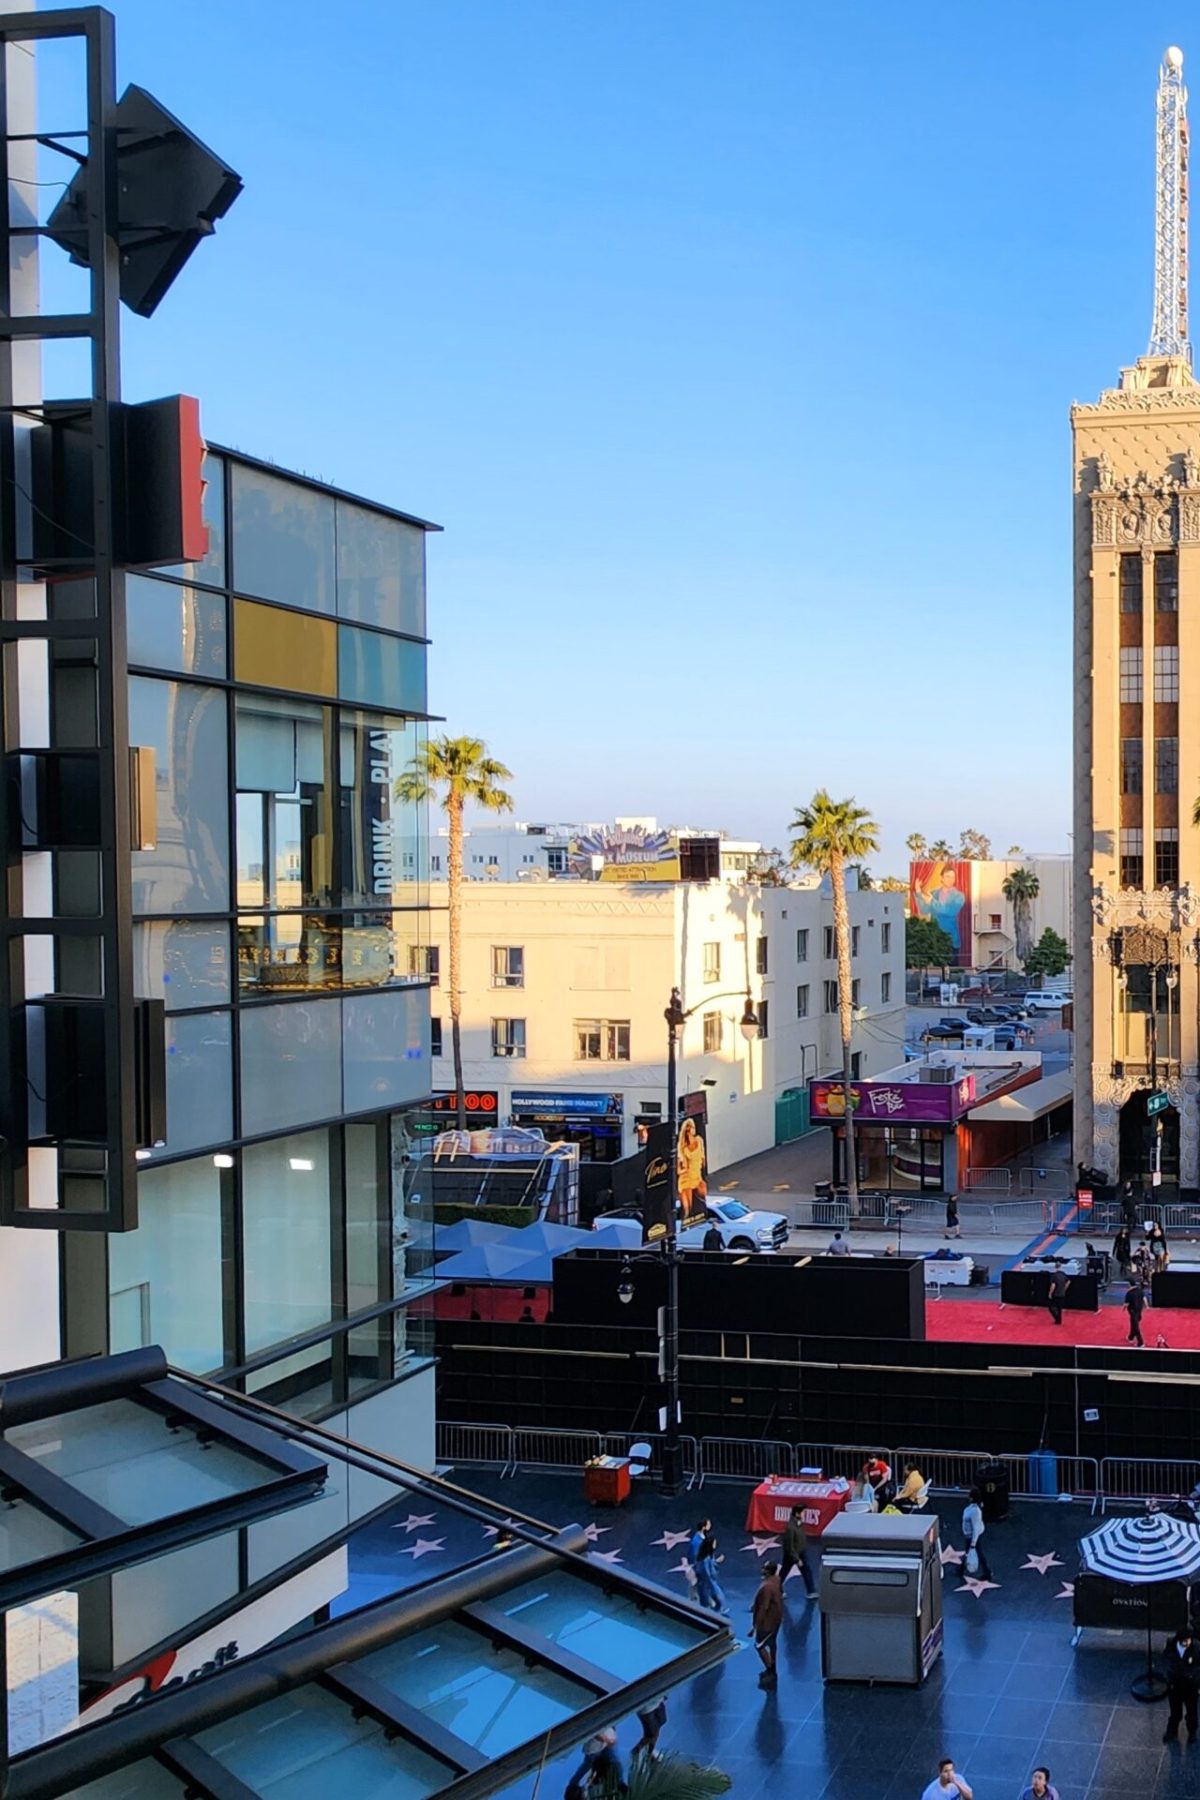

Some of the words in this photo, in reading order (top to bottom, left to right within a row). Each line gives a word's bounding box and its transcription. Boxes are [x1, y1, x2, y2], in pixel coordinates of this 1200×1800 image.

[372, 817, 396, 895] DRINK
[615, 849, 659, 864] MUSEUM
[512, 1099, 554, 1107] HOLLYWOOD
[1112, 1598, 1149, 1607] OVATION
